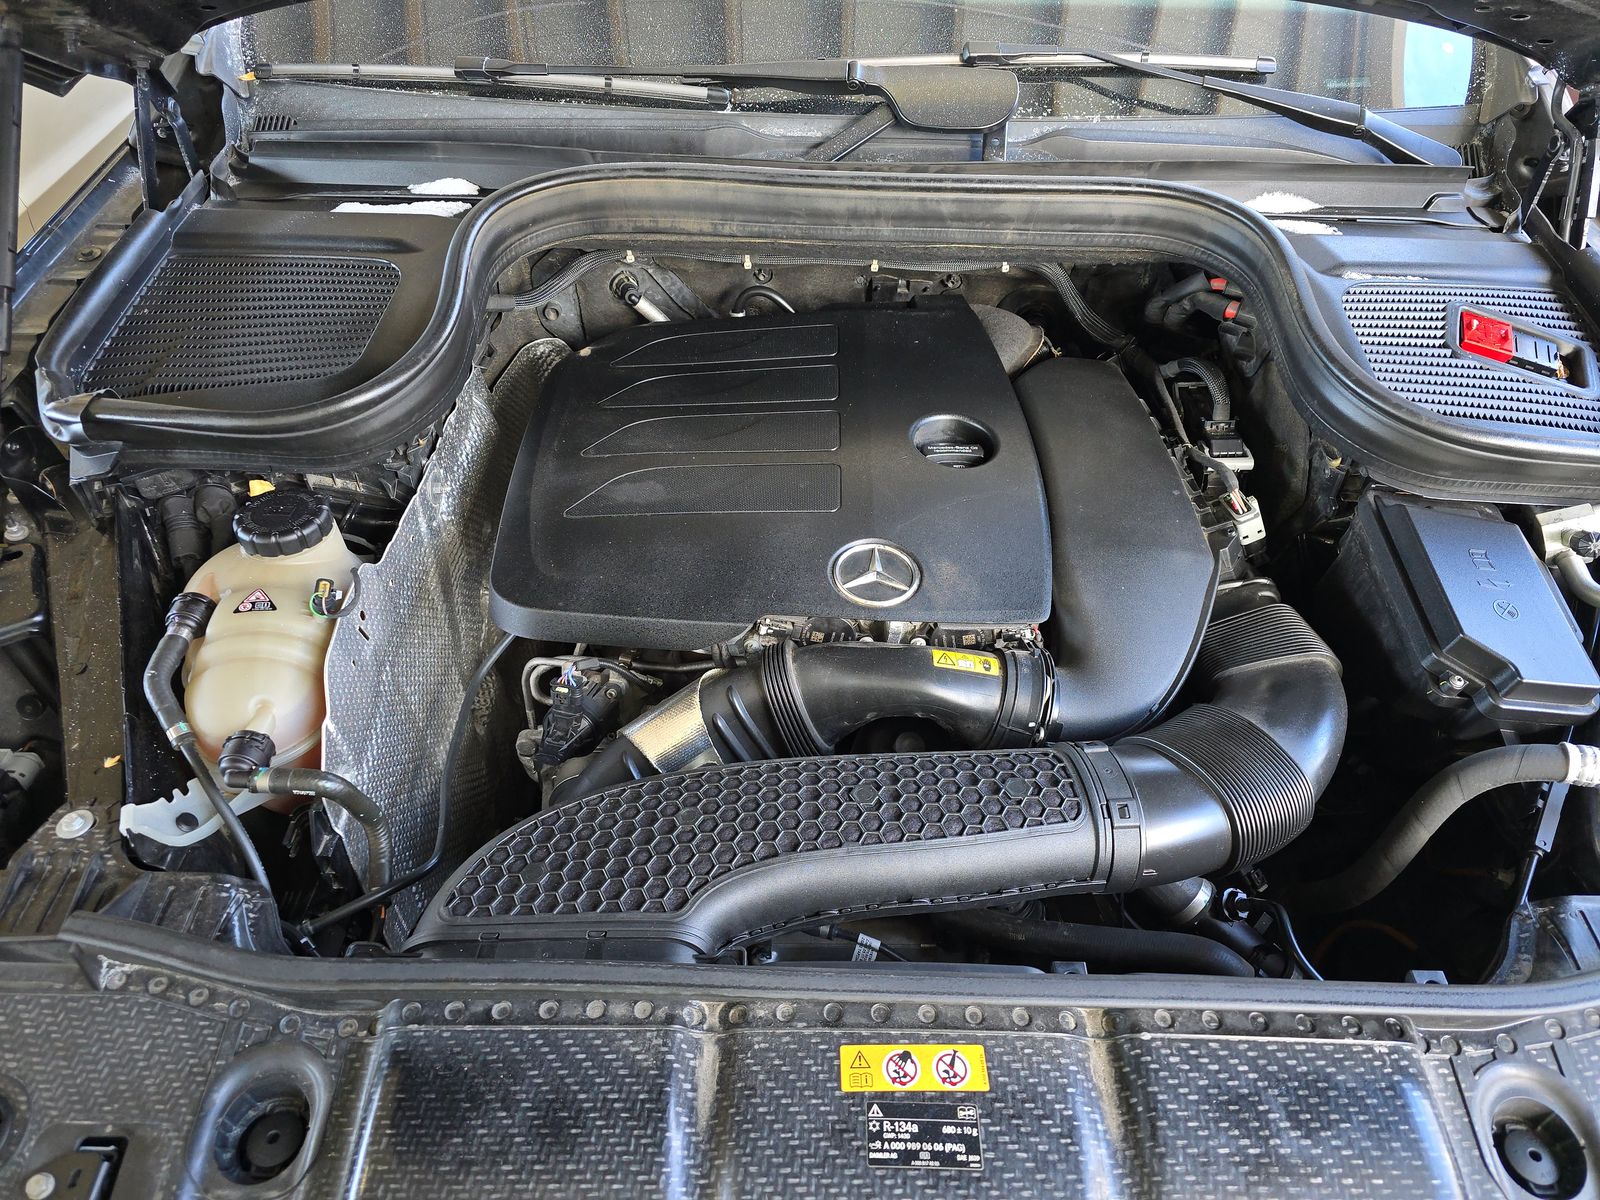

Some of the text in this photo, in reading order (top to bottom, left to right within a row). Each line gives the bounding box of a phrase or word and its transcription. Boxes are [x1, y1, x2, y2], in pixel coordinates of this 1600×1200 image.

[883, 1121, 919, 1133] R-134a
[963, 1126, 972, 1135] 10
[883, 1141, 966, 1153] A 000 989 06 06 (PAG)
